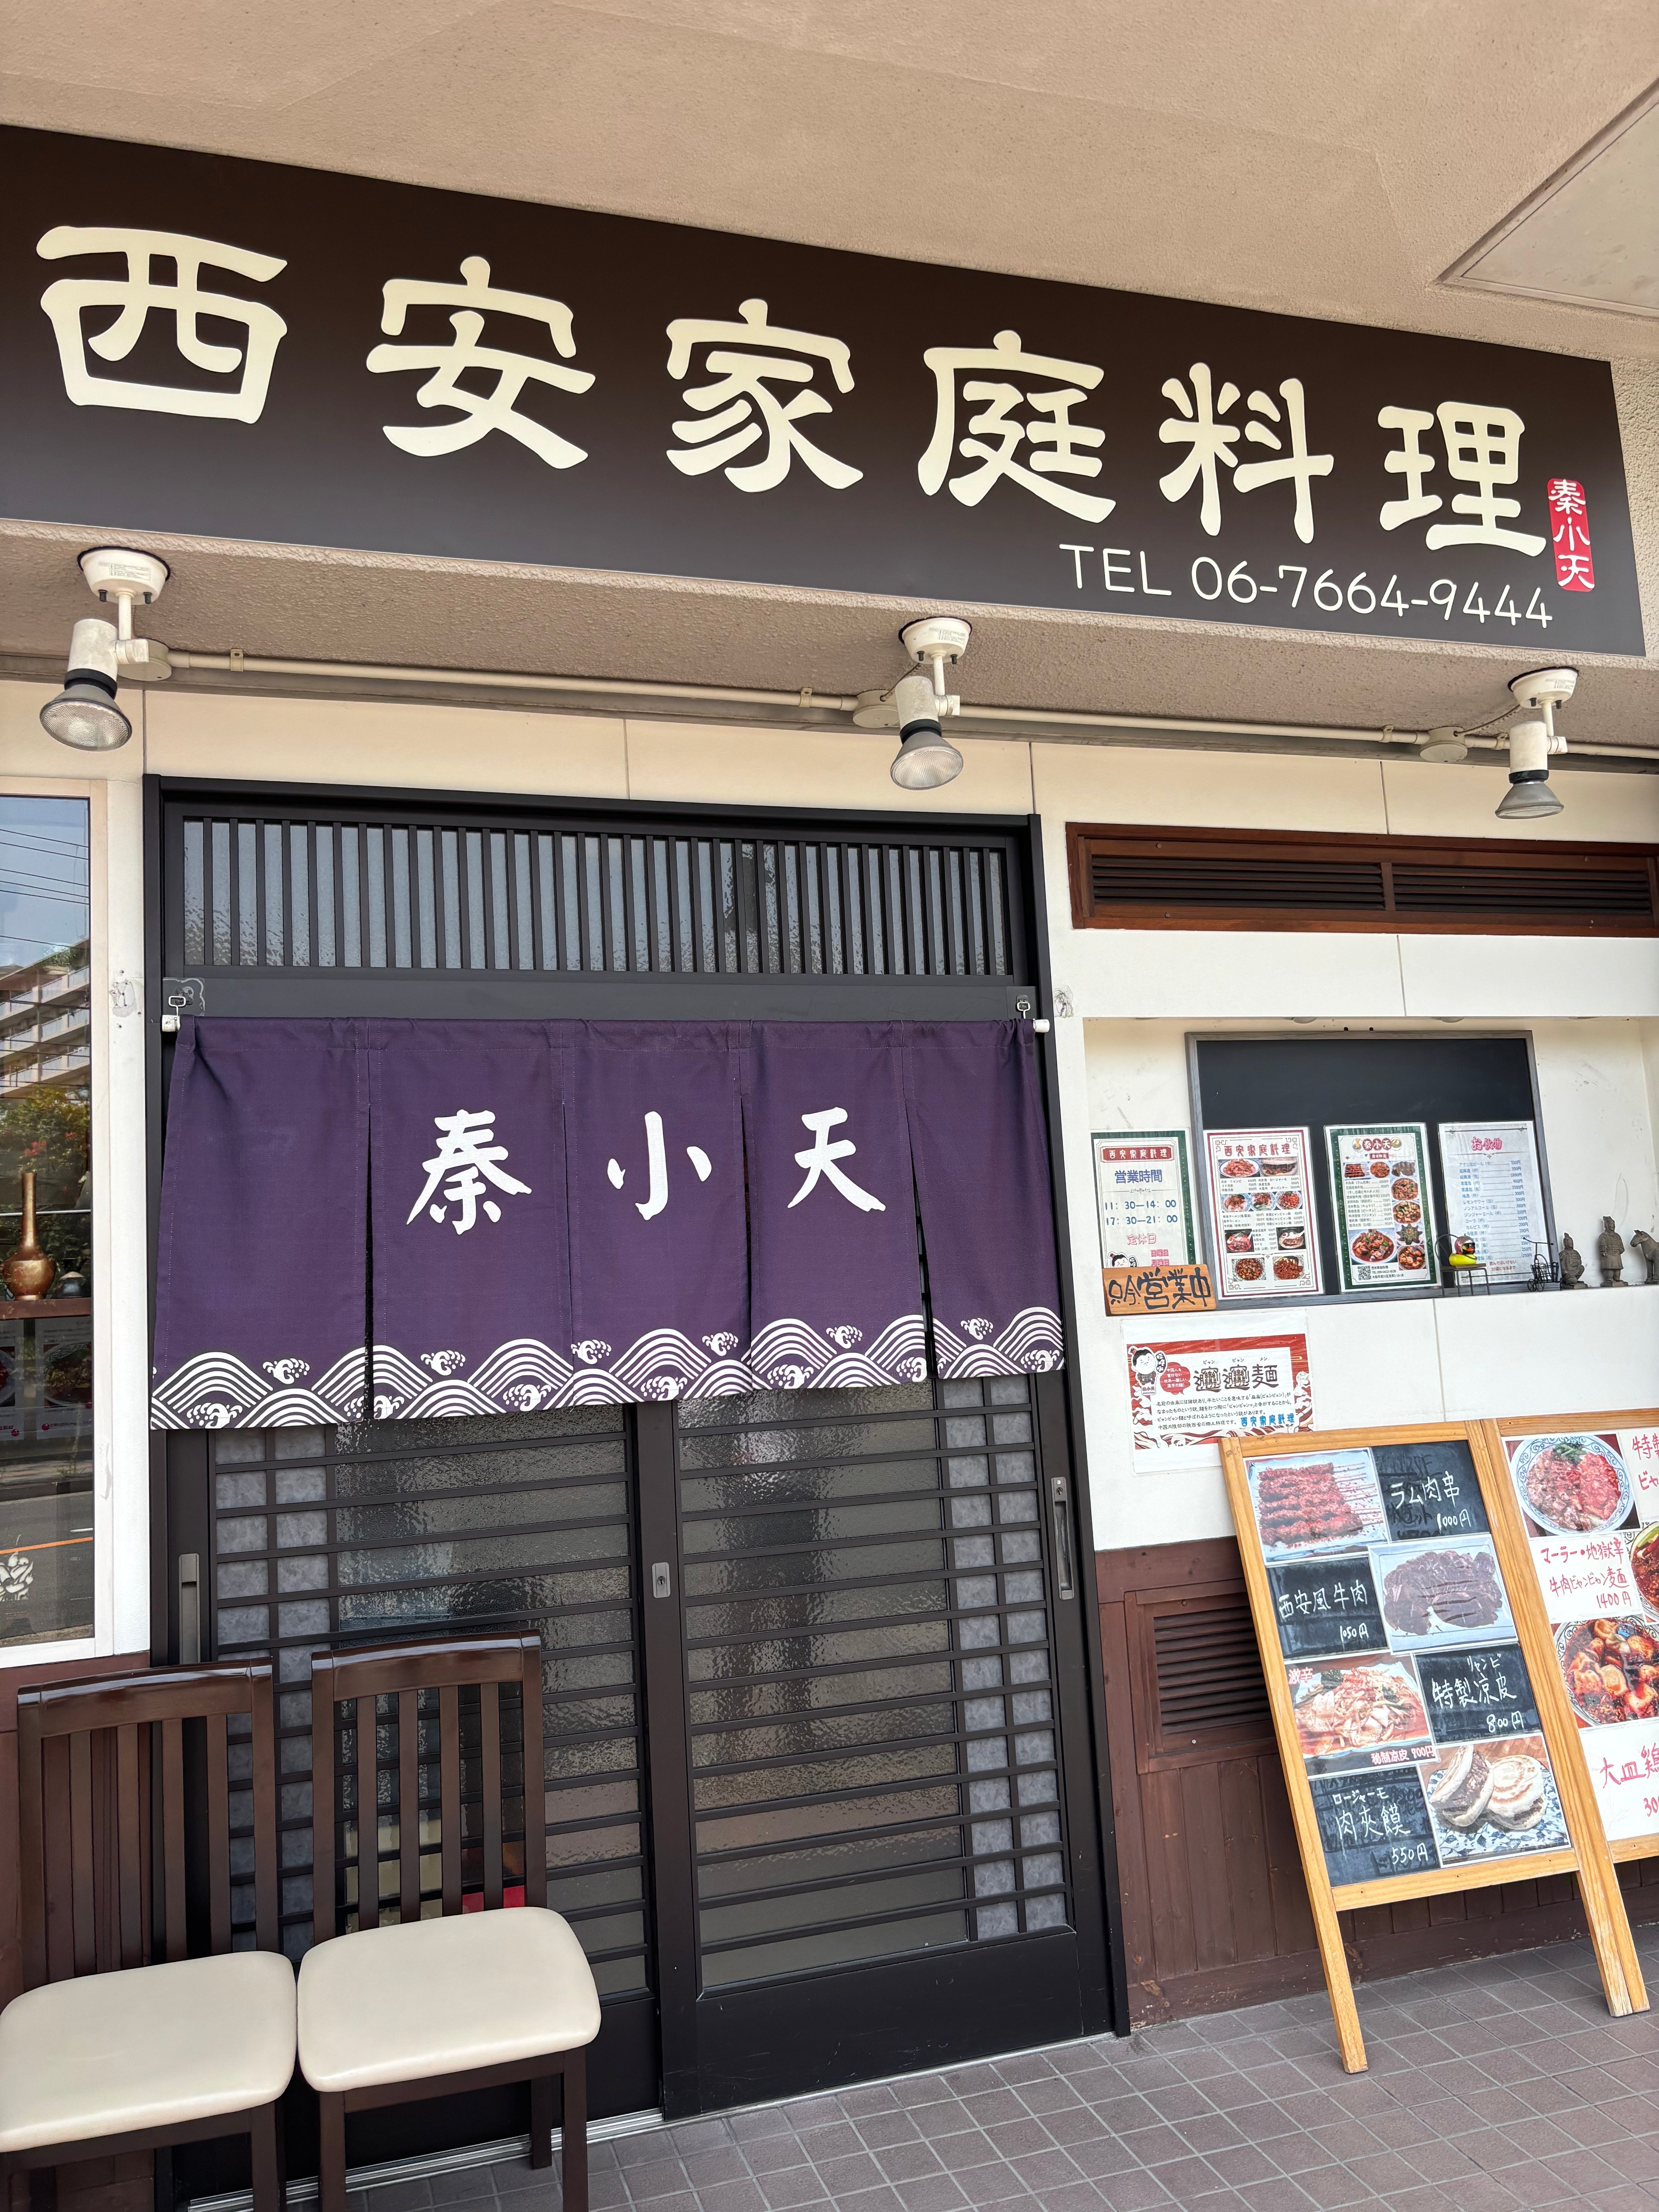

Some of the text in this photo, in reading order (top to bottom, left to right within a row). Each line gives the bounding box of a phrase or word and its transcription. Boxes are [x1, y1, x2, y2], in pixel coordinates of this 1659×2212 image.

[36, 225, 1546, 556] 西安家庭料理
[1549, 479, 1594, 589] 秦小天
[1059, 543, 1553, 628] TEL 06-7664-9444
[1109, 1149, 1168, 1159] 西安家庭料理
[1224, 1143, 1291, 1157] 西安家庭料理
[1471, 1136, 1503, 1151] お飲物
[406, 1107, 886, 1235] 秦小天
[1114, 1169, 1163, 1184] 営業時間
[1126, 1233, 1157, 1245] 定休日
[1108, 1267, 1211, 1310] 只今営業中
[1240, 1413, 1295, 1427] 西安家庭料理
[1390, 1470, 1460, 1510] ラム肉串
[1436, 1509, 1471, 1532] 1000円
[1549, 1566, 1630, 1597] 牛肉ビャンビャン麺
[1278, 1579, 1367, 1618] 西安風牛肉
[1596, 1591, 1632, 1609] 1400円
[1340, 1623, 1369, 1639] 1050円
[1288, 1666, 1313, 1685] 激辛
[1486, 1710, 1524, 1733] 800円
[1332, 1787, 1389, 1805] ロージャーモ
[1643, 1796, 1659, 1817] 30
[1392, 1842, 1429, 1865] 550円
